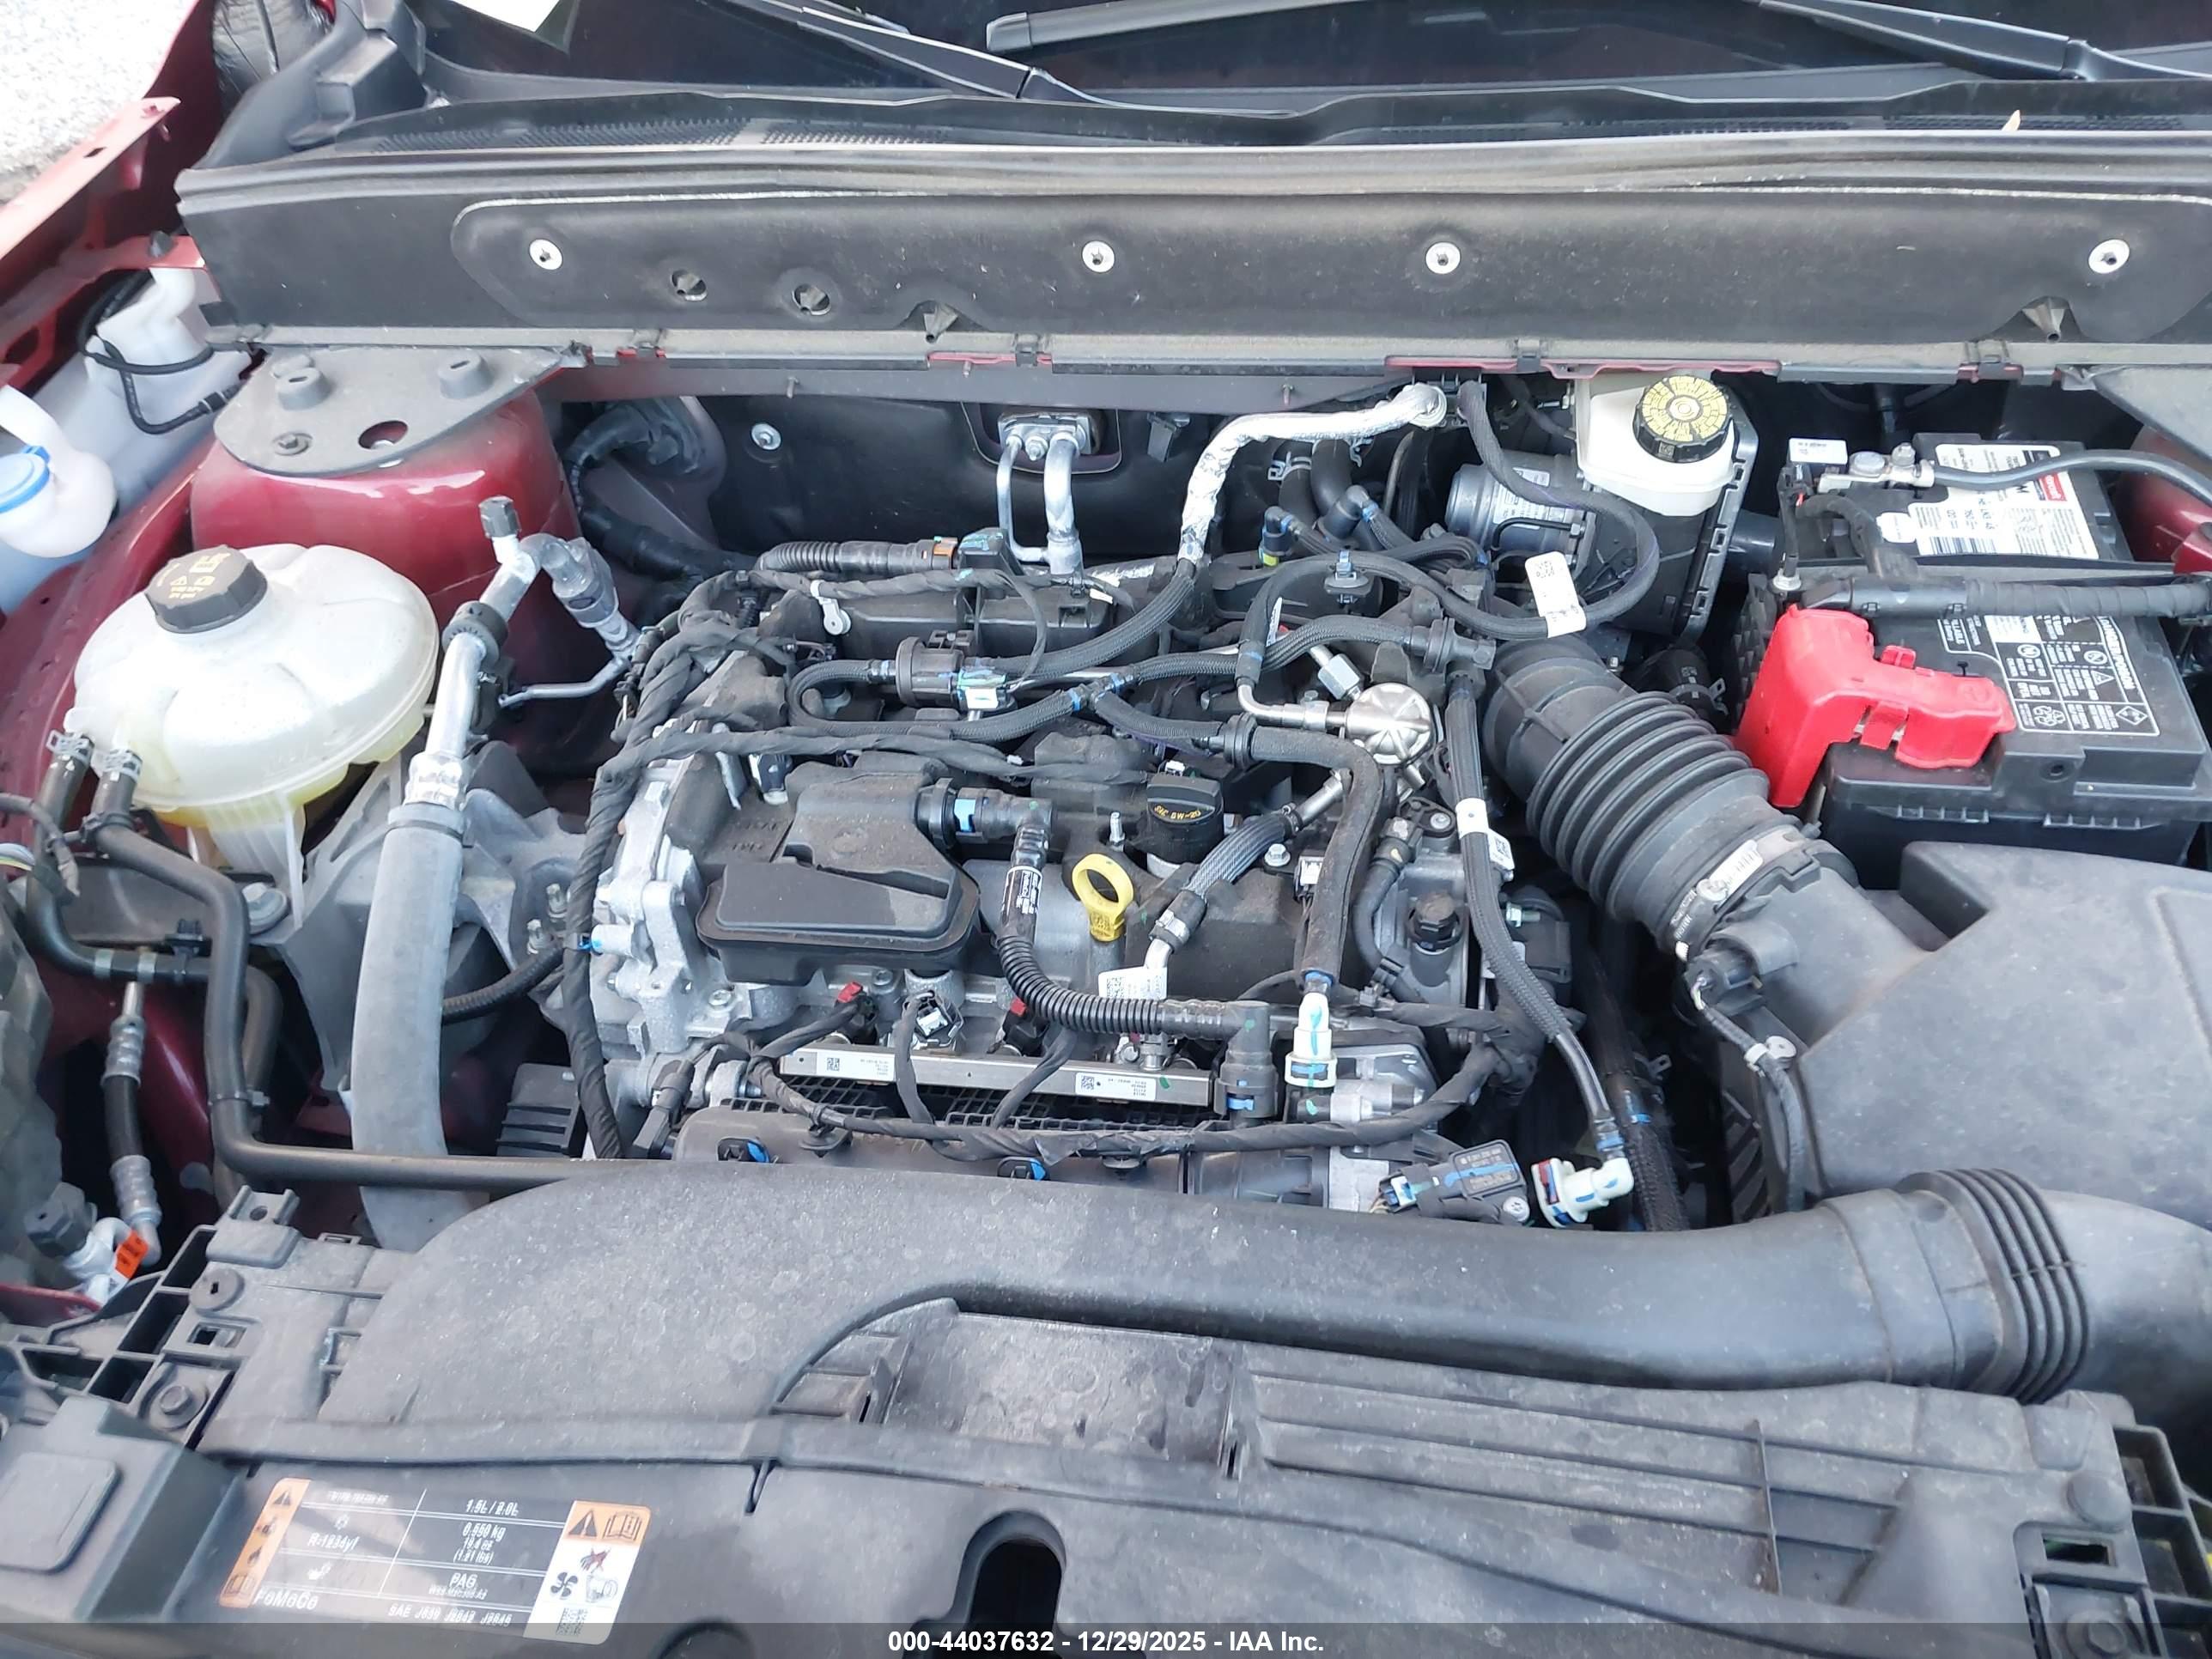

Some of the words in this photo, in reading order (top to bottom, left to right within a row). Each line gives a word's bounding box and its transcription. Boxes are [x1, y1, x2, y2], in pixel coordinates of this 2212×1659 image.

[449, 1572, 478, 1589] PAG
[254, 1587, 319, 1610] FoMoCo
[388, 1603, 412, 1618] SAE
